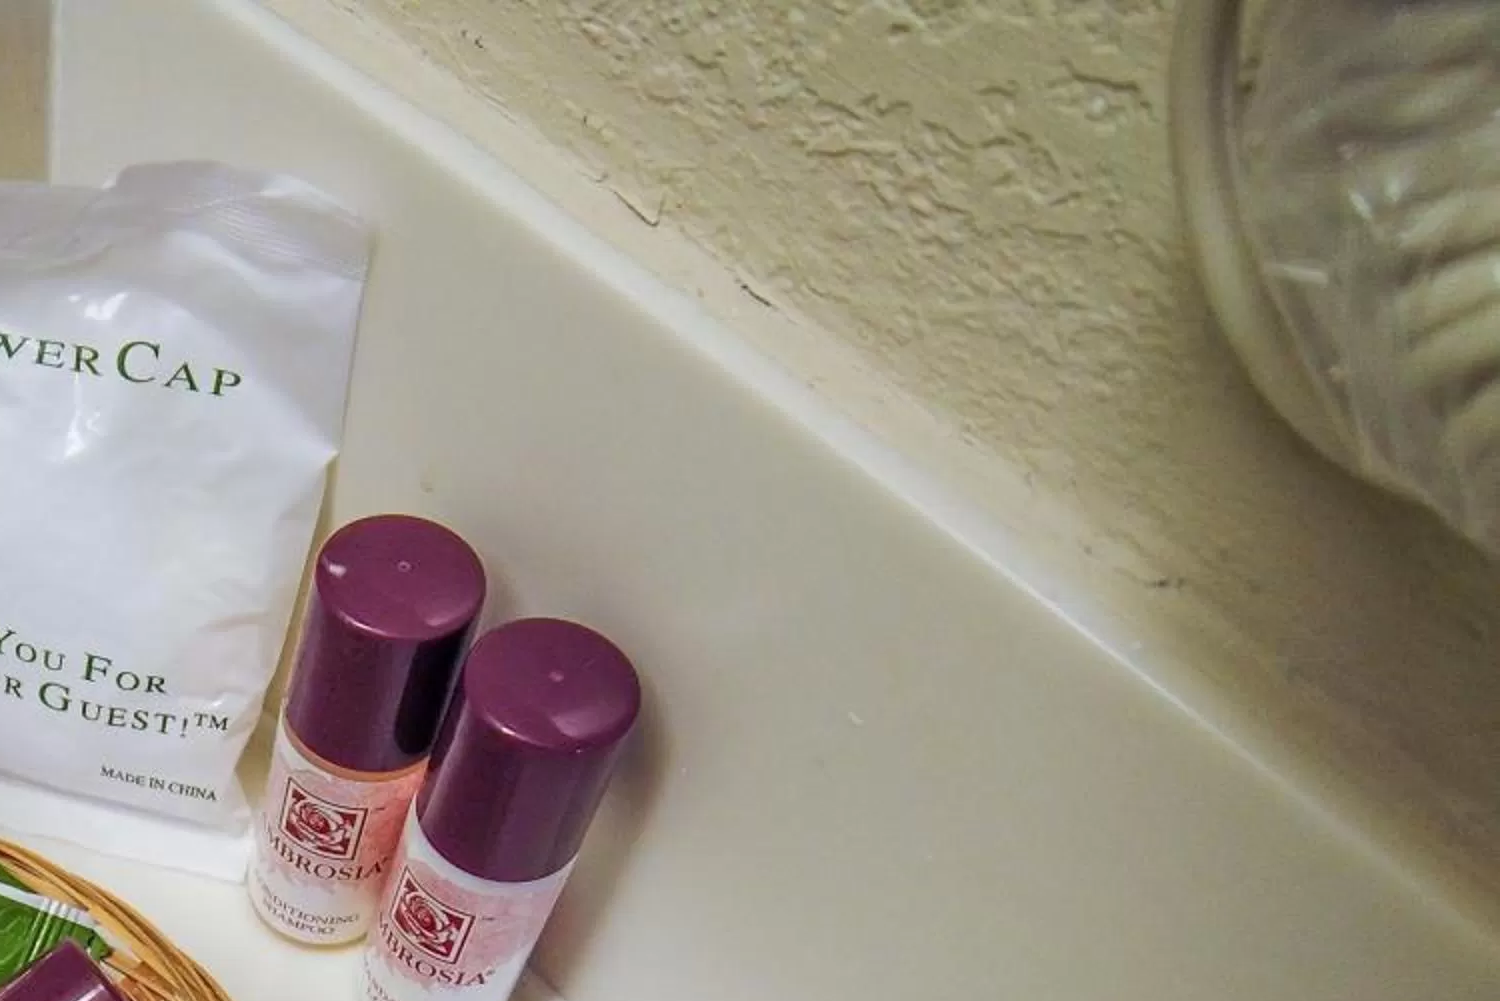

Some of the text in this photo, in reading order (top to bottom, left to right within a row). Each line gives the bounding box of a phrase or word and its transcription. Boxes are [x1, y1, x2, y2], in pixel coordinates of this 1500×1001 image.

[82, 652, 167, 694] FOR
[100, 766, 218, 802] MADE IN CHINA
